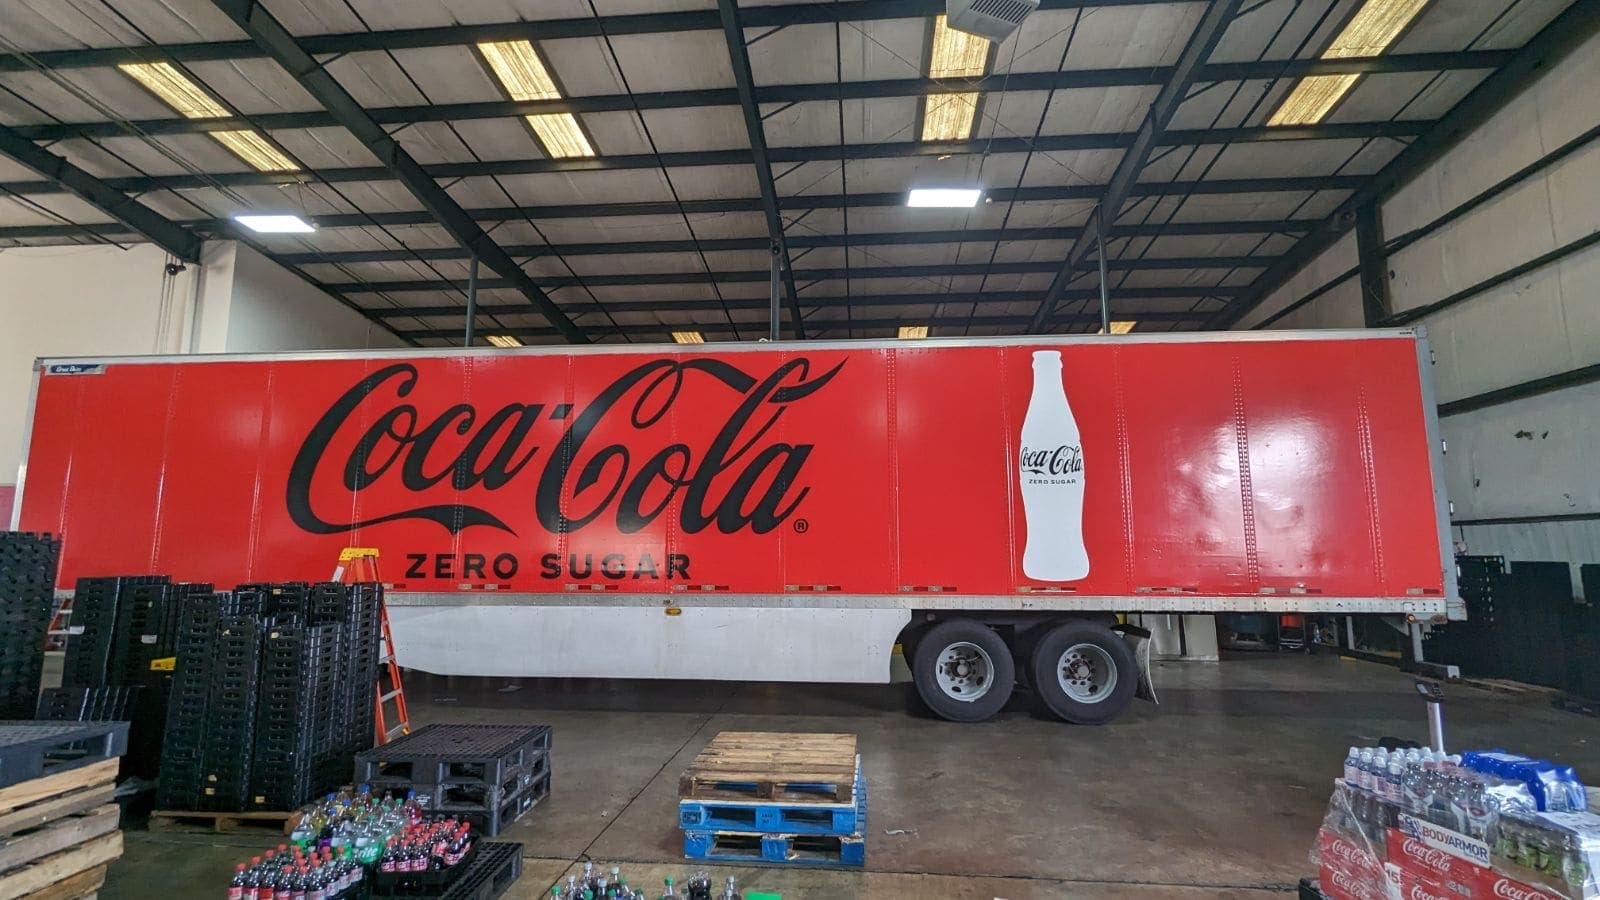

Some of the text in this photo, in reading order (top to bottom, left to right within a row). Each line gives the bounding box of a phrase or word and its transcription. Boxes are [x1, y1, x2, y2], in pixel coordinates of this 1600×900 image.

[285, 357, 849, 536] Coca-Cola
[1020, 445, 1083, 476] Coca-Cola
[405, 553, 692, 580] ZERO SUGAR
[1422, 826, 1488, 860] BODYARMOR
